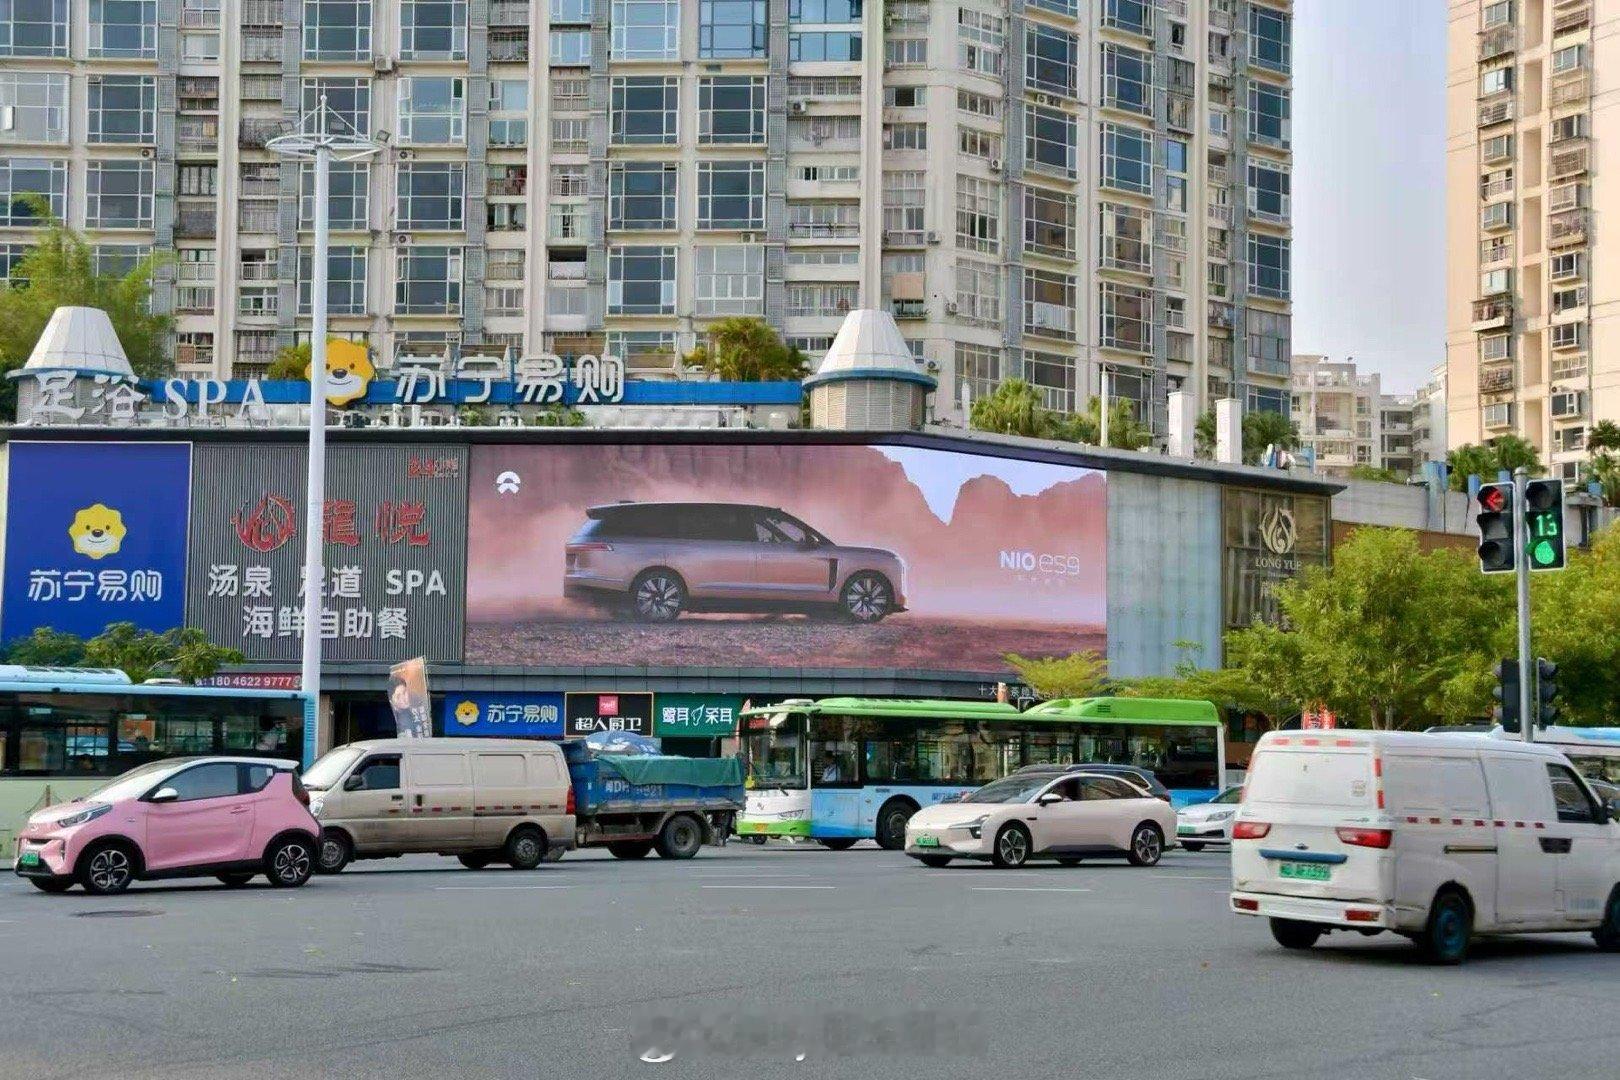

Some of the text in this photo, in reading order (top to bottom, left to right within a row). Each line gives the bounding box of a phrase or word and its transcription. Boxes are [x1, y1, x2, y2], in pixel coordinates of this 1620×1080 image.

[394, 353, 625, 403] 苏宁易购
[30, 370, 271, 421] 足浴 SPA
[999, 551, 1036, 571] NIO
[1255, 557, 1282, 569] LONG
[27, 569, 162, 602] 苏宁易购
[207, 563, 273, 598] 汤泉
[385, 569, 447, 596] SPA
[242, 605, 408, 640] 海鲜自助餐
[210, 676, 231, 687] 180
[232, 676, 262, 687] 4622
[263, 676, 292, 688] 9777
[486, 704, 559, 723] 苏宁易购
[575, 717, 642, 732] 超人厨卫
